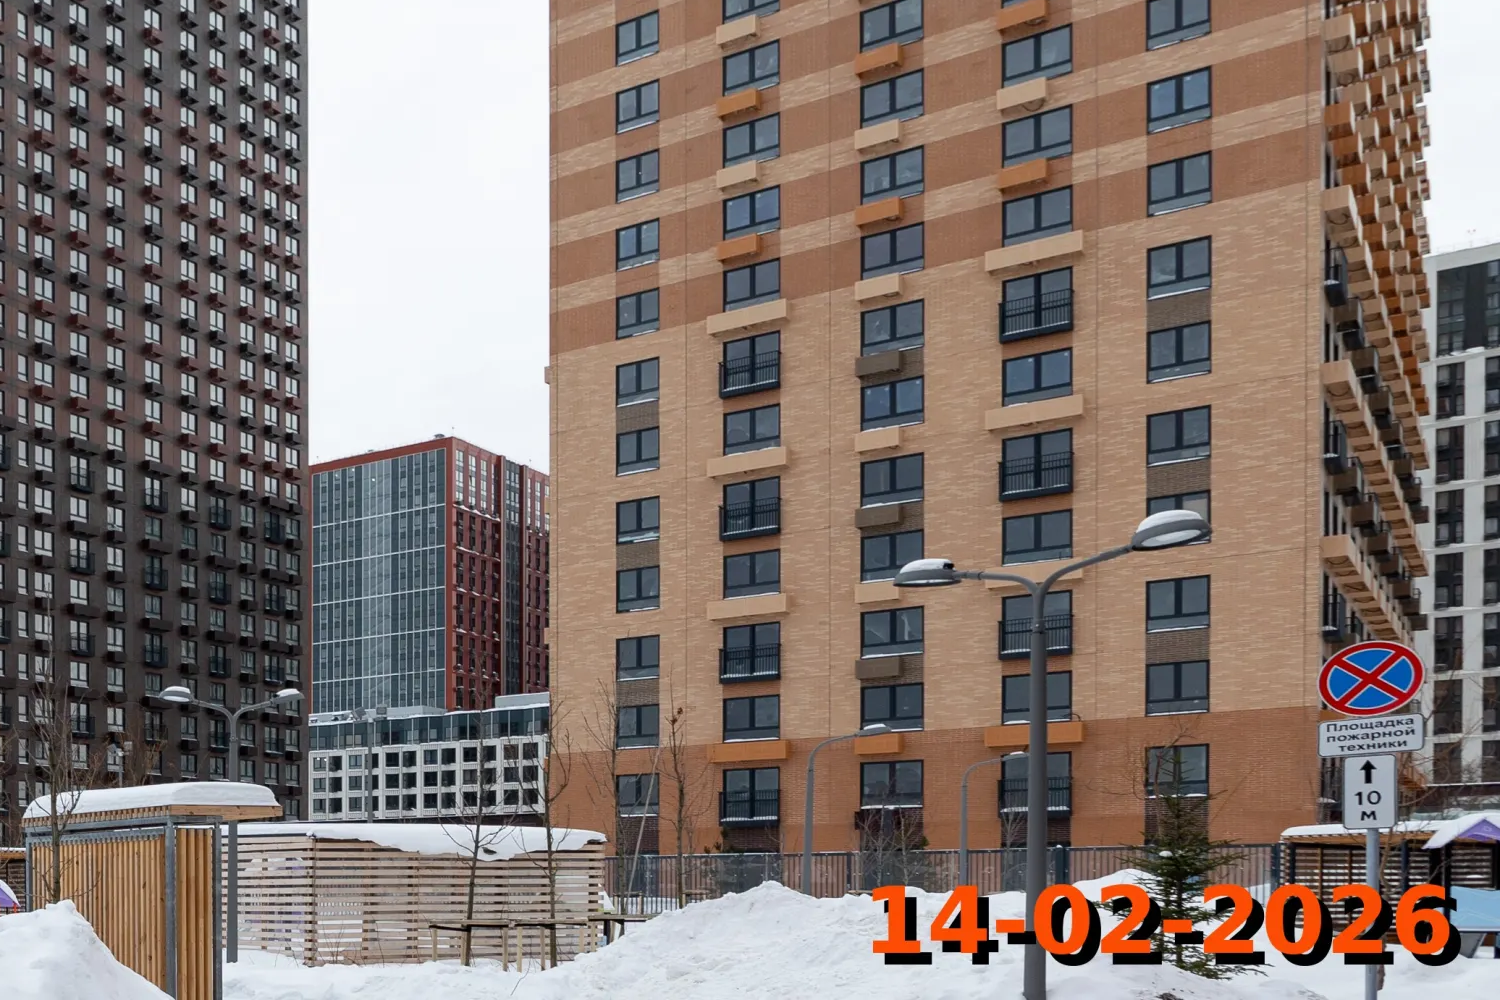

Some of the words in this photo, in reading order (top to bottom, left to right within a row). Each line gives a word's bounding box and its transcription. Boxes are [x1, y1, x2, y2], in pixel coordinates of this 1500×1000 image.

[1326, 717, 1414, 733] Площадка
[1326, 727, 1415, 743] пожарной
[1338, 740, 1408, 752] техники
[1354, 790, 1381, 805] 10
